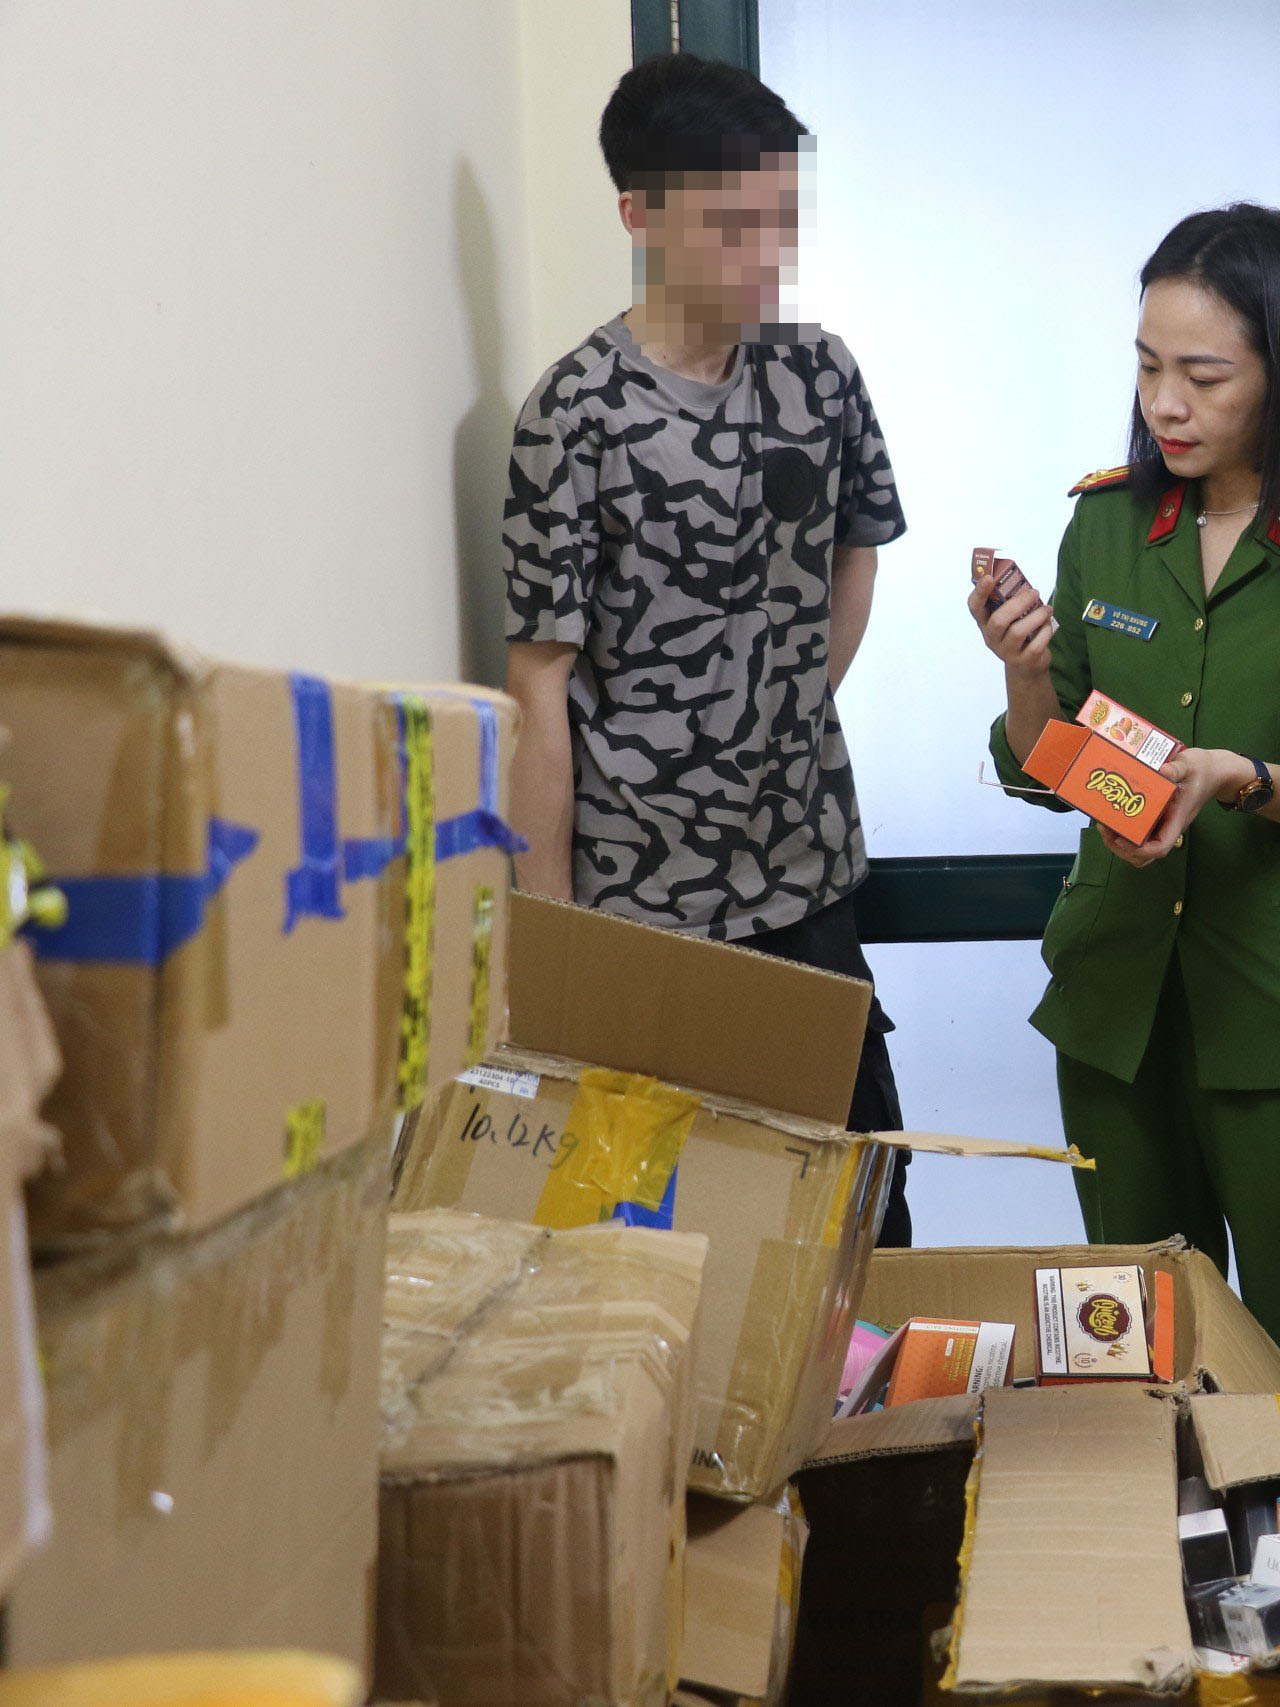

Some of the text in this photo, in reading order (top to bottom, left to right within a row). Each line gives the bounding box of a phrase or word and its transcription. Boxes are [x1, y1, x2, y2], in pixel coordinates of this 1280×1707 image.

[1086, 769, 1146, 817] Queen
[1044, 1313, 1052, 1333] ADDICTIVE
[1051, 1303, 1059, 1323] PRODUCT
[1088, 1298, 1119, 1336] Queen
[971, 1365, 984, 1394] ARNING:
